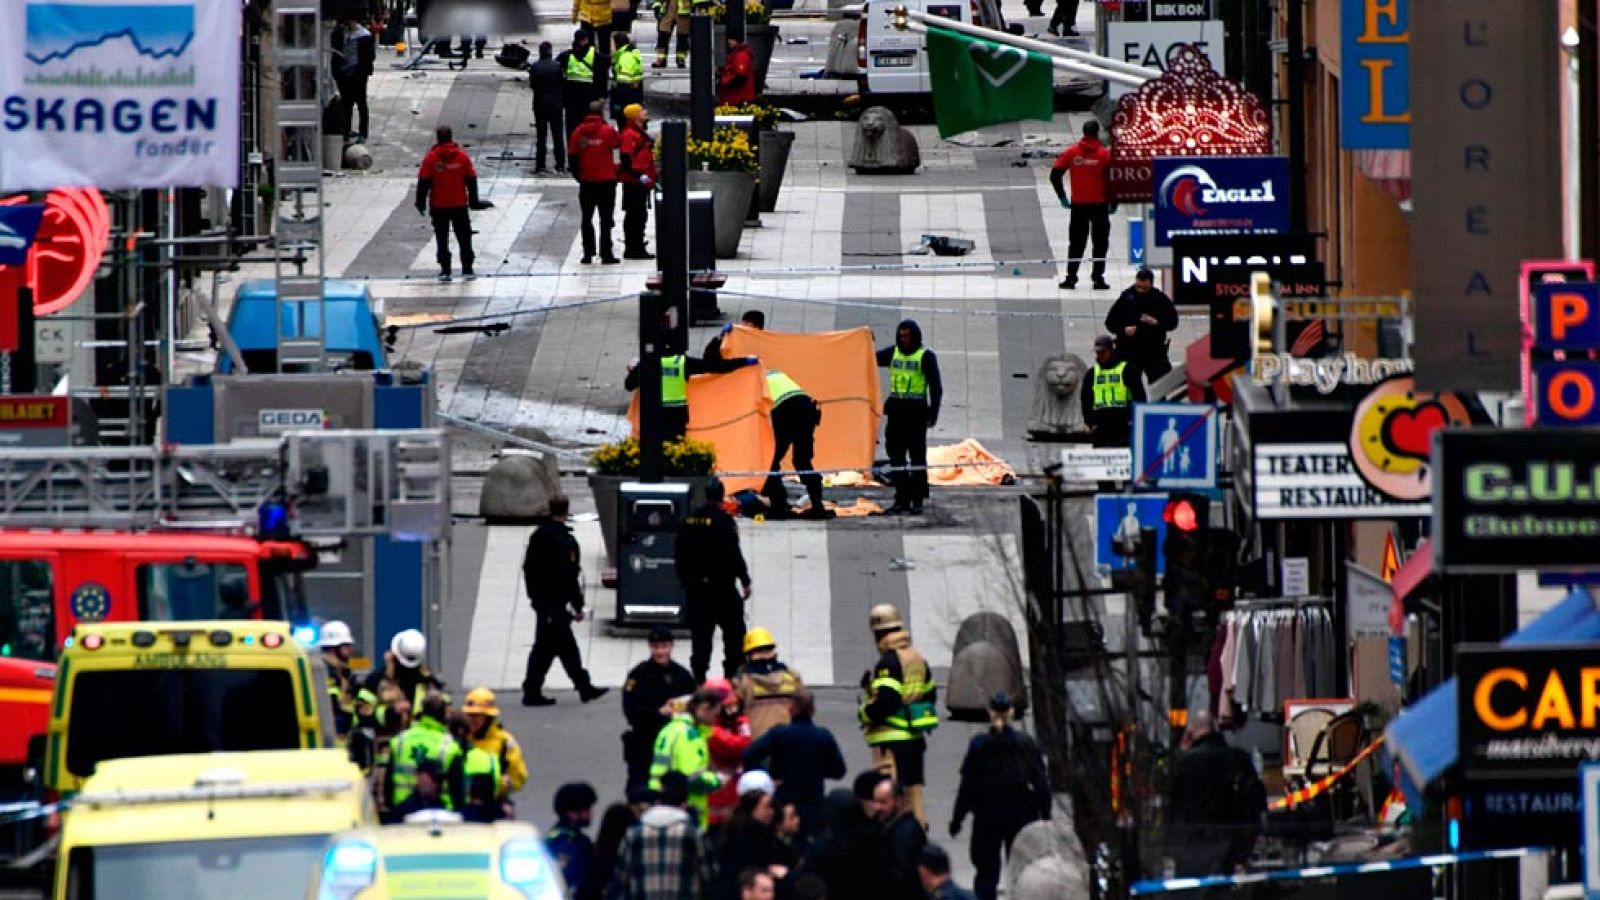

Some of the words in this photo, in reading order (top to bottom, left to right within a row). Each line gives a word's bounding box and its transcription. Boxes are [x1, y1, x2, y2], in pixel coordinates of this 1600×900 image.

[1155, 5, 1177, 16] BIK
[1178, 5, 1206, 16] BOK
[4, 96, 217, 133] SKAGEN
[135, 138, 214, 157] fonder
[262, 412, 321, 426] GEDA
[1267, 455, 1350, 475] TEATER
[1466, 464, 1600, 500] C.U.
